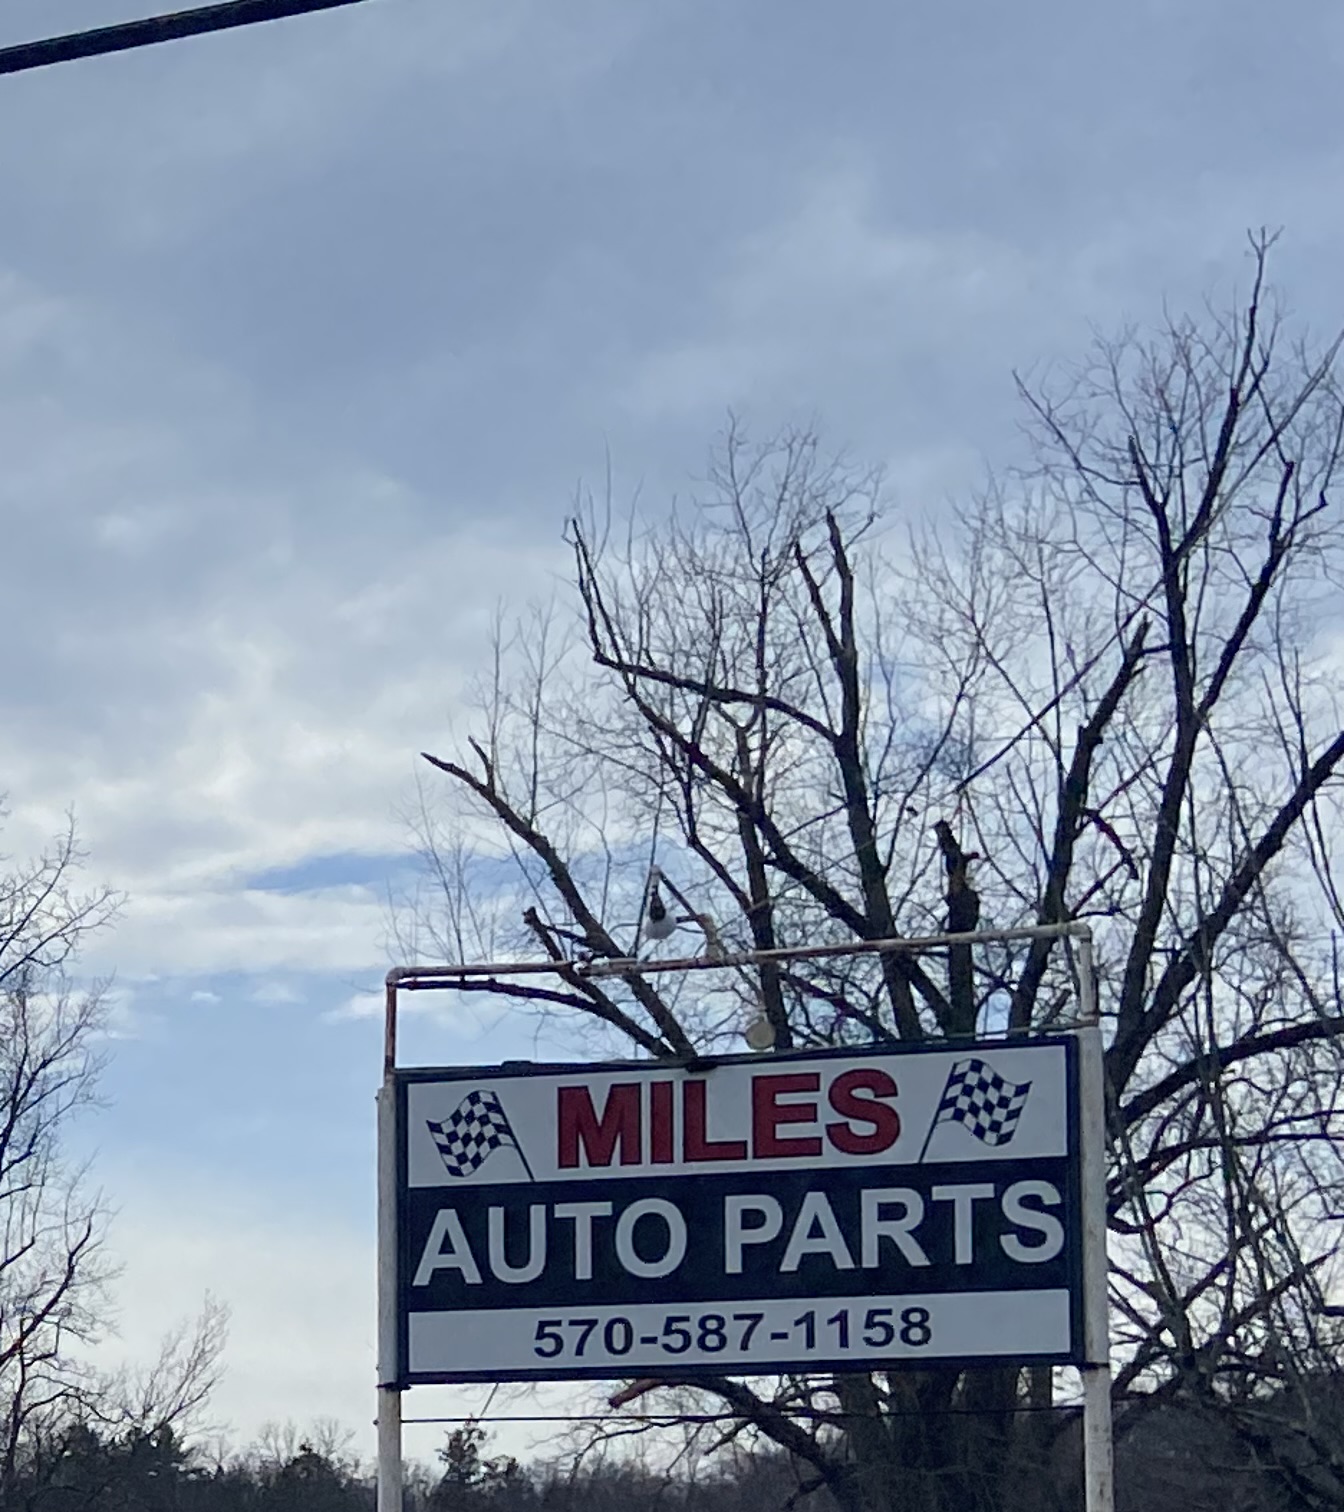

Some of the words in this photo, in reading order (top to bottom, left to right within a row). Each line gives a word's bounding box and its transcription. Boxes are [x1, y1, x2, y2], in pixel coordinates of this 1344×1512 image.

[557, 1068, 901, 1169] MILES
[412, 1199, 688, 1286] AUTO
[725, 1180, 1065, 1275] PARTS
[533, 1307, 933, 1358] 570-587-1158
